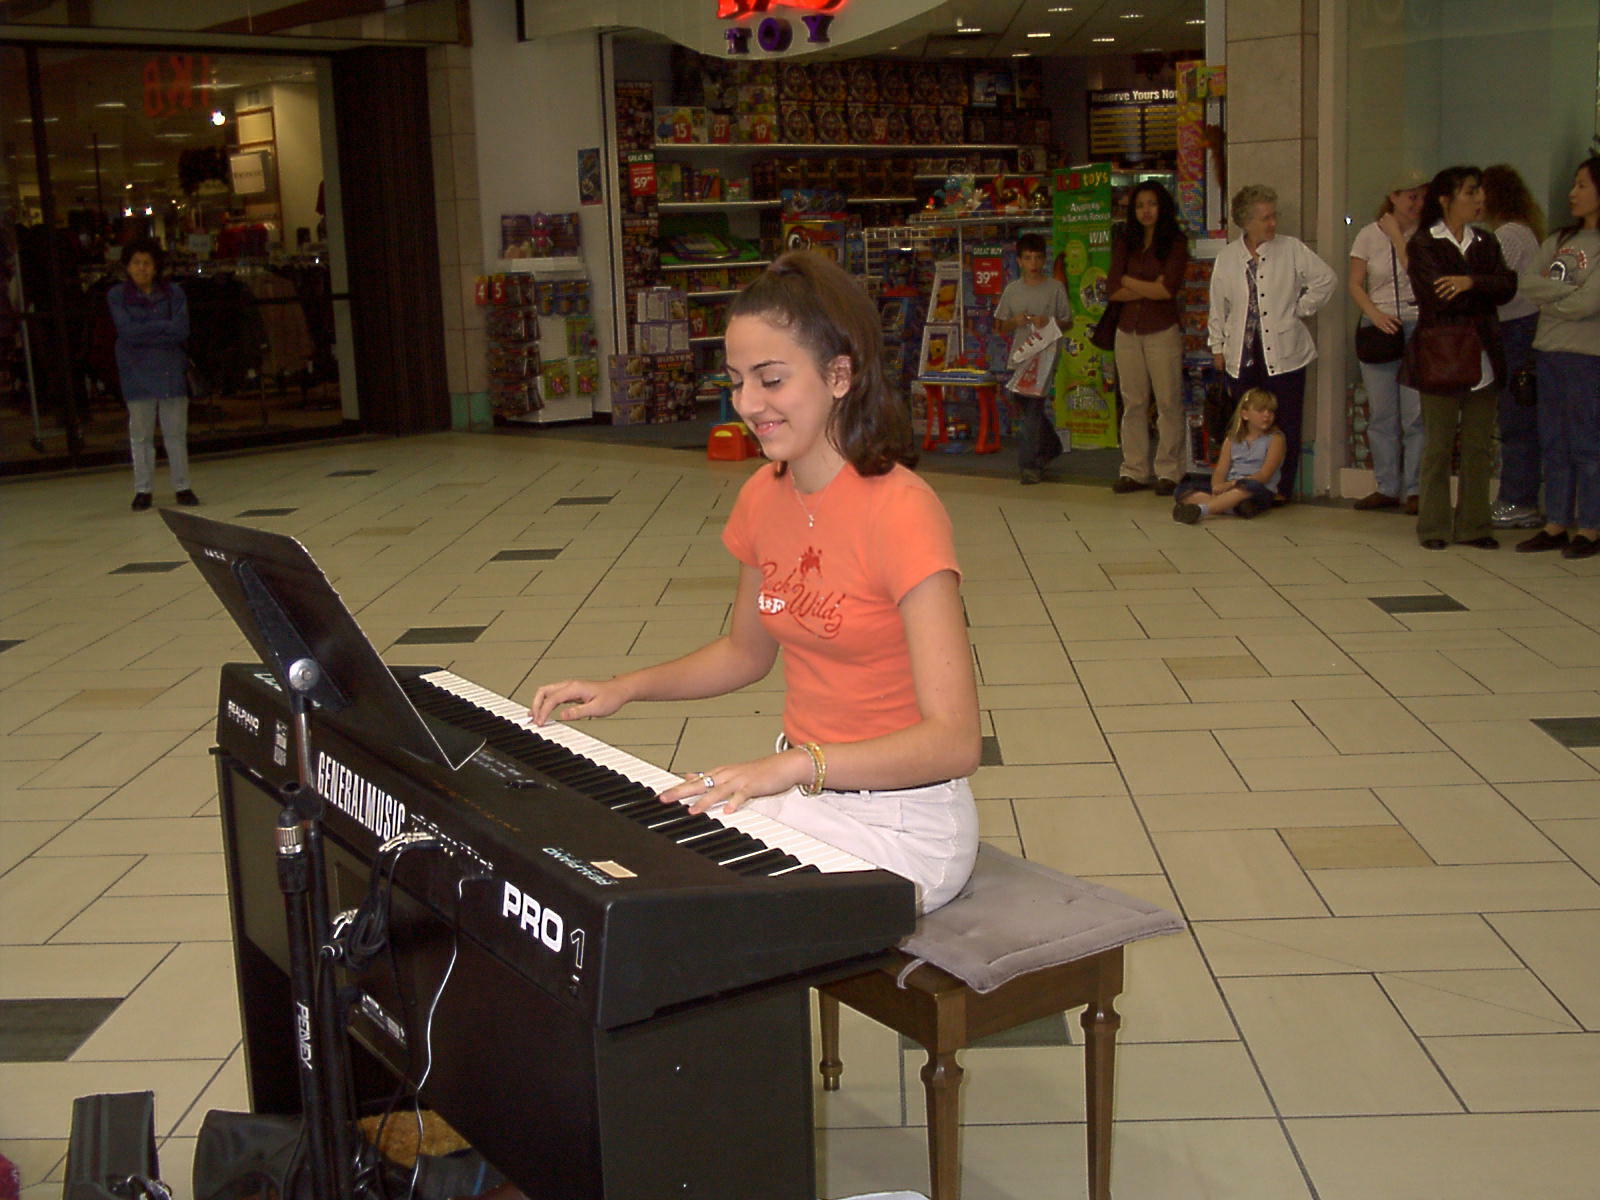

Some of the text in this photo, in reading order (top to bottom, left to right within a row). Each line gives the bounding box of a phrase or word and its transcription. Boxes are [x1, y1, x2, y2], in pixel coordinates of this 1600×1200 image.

[724, 13, 834, 54] TOY
[1132, 90, 1160, 101] Yours
[676, 122, 687, 138] 15
[1083, 171, 1109, 187] toys
[1089, 230, 1110, 244] WIN
[495, 281, 502, 298] 5
[317, 751, 406, 842] GENERALMUSIC
[502, 881, 585, 969] PRO 1
[297, 1001, 313, 1070] PEAVEY
